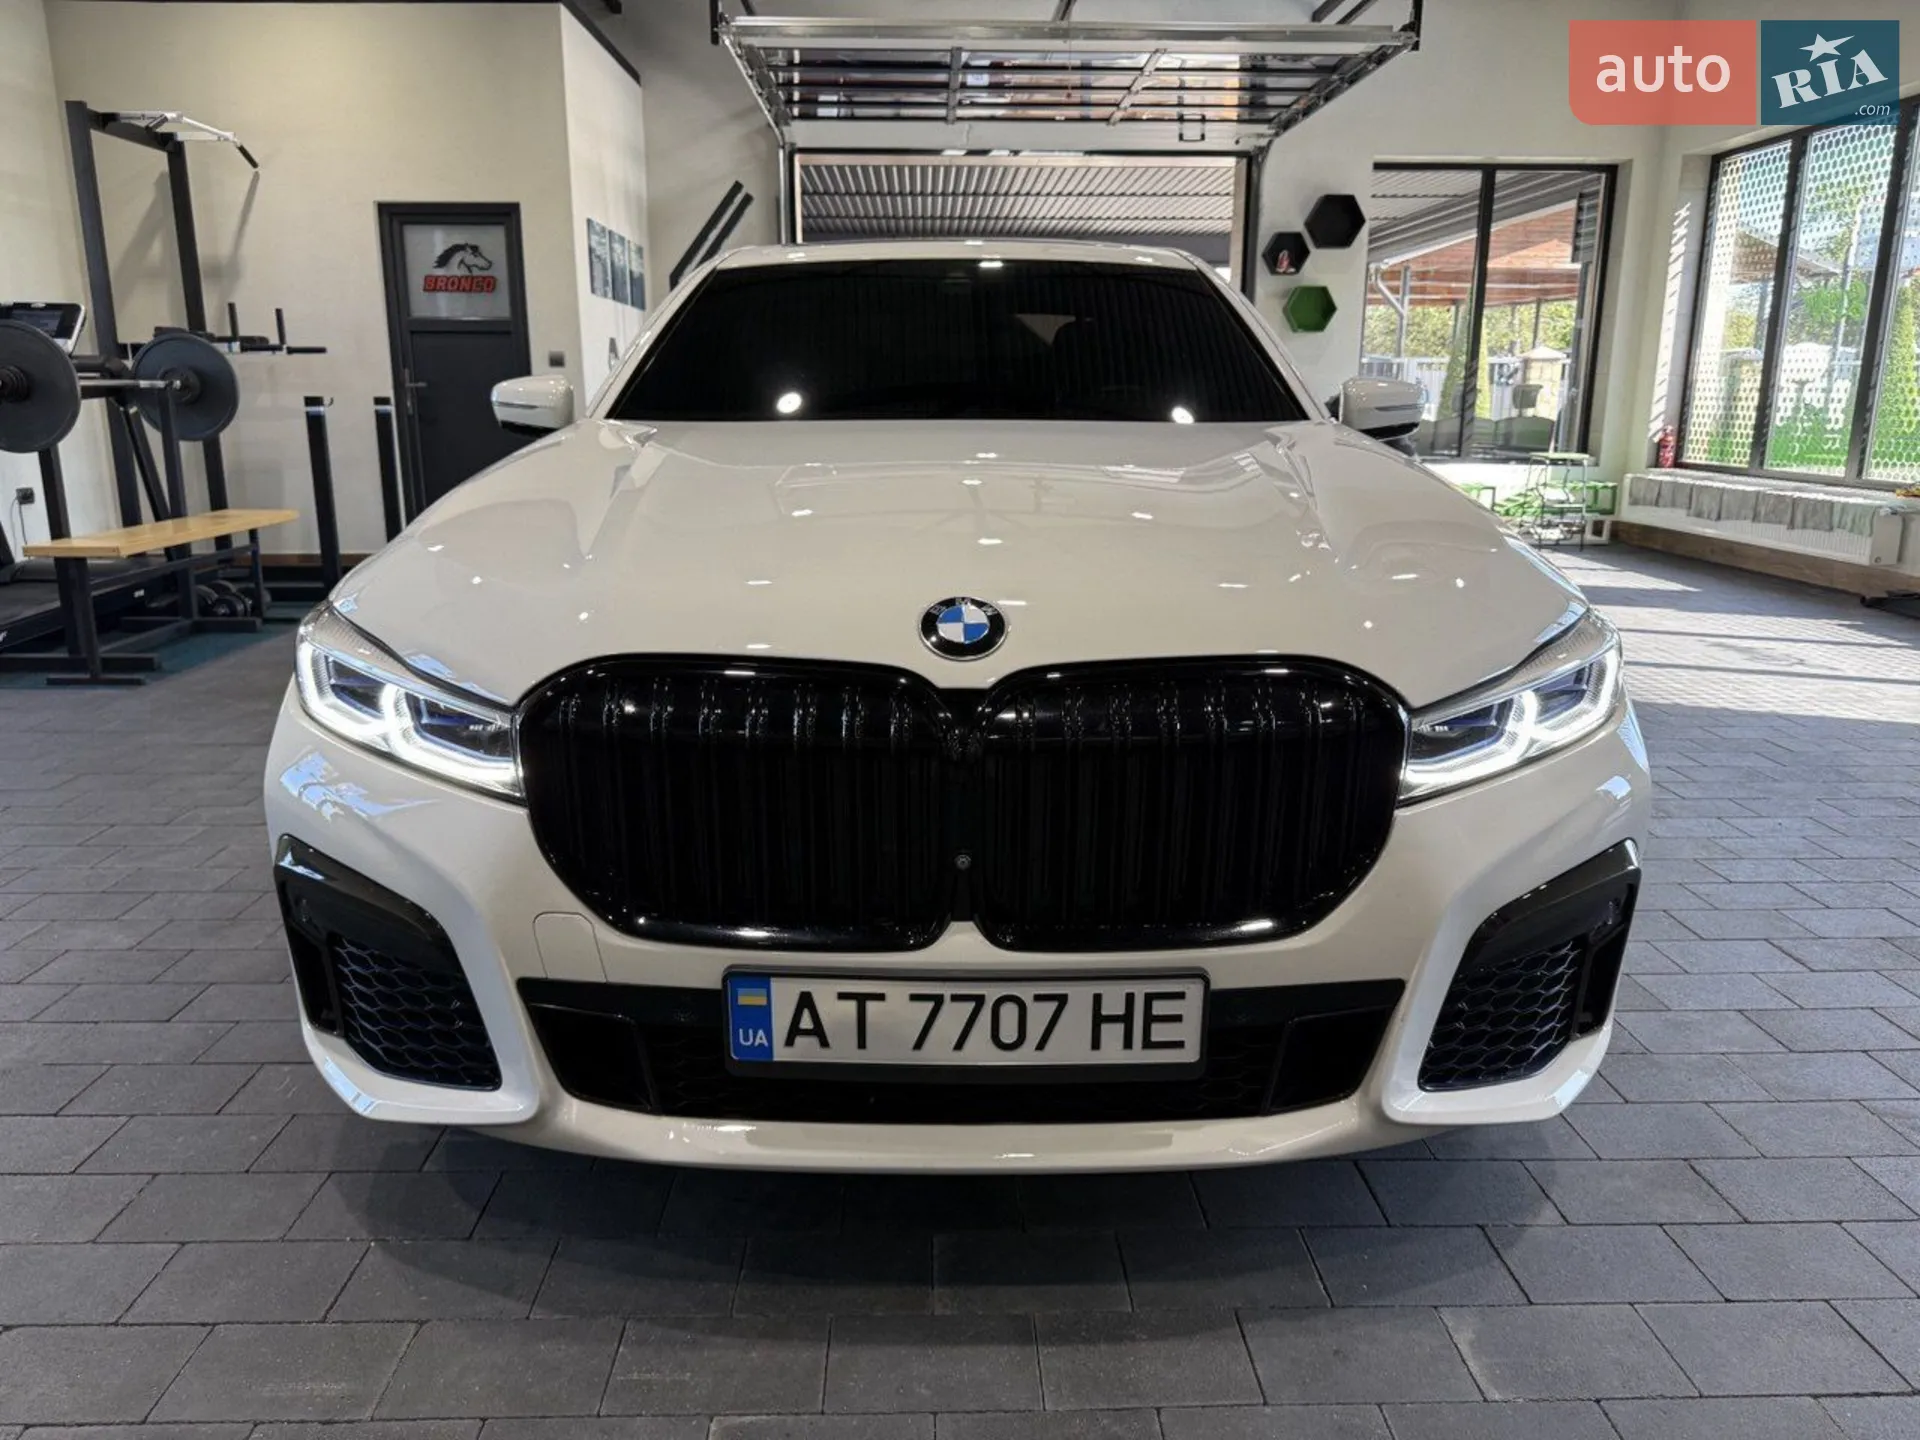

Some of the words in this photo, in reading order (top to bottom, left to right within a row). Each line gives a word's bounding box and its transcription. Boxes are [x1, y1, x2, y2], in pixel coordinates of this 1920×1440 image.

[423, 276, 497, 293] BRONCO
[784, 991, 886, 1050] AT
[909, 993, 1069, 1051] 7707
[1090, 991, 1186, 1051] HE
[738, 1028, 768, 1047] UA
